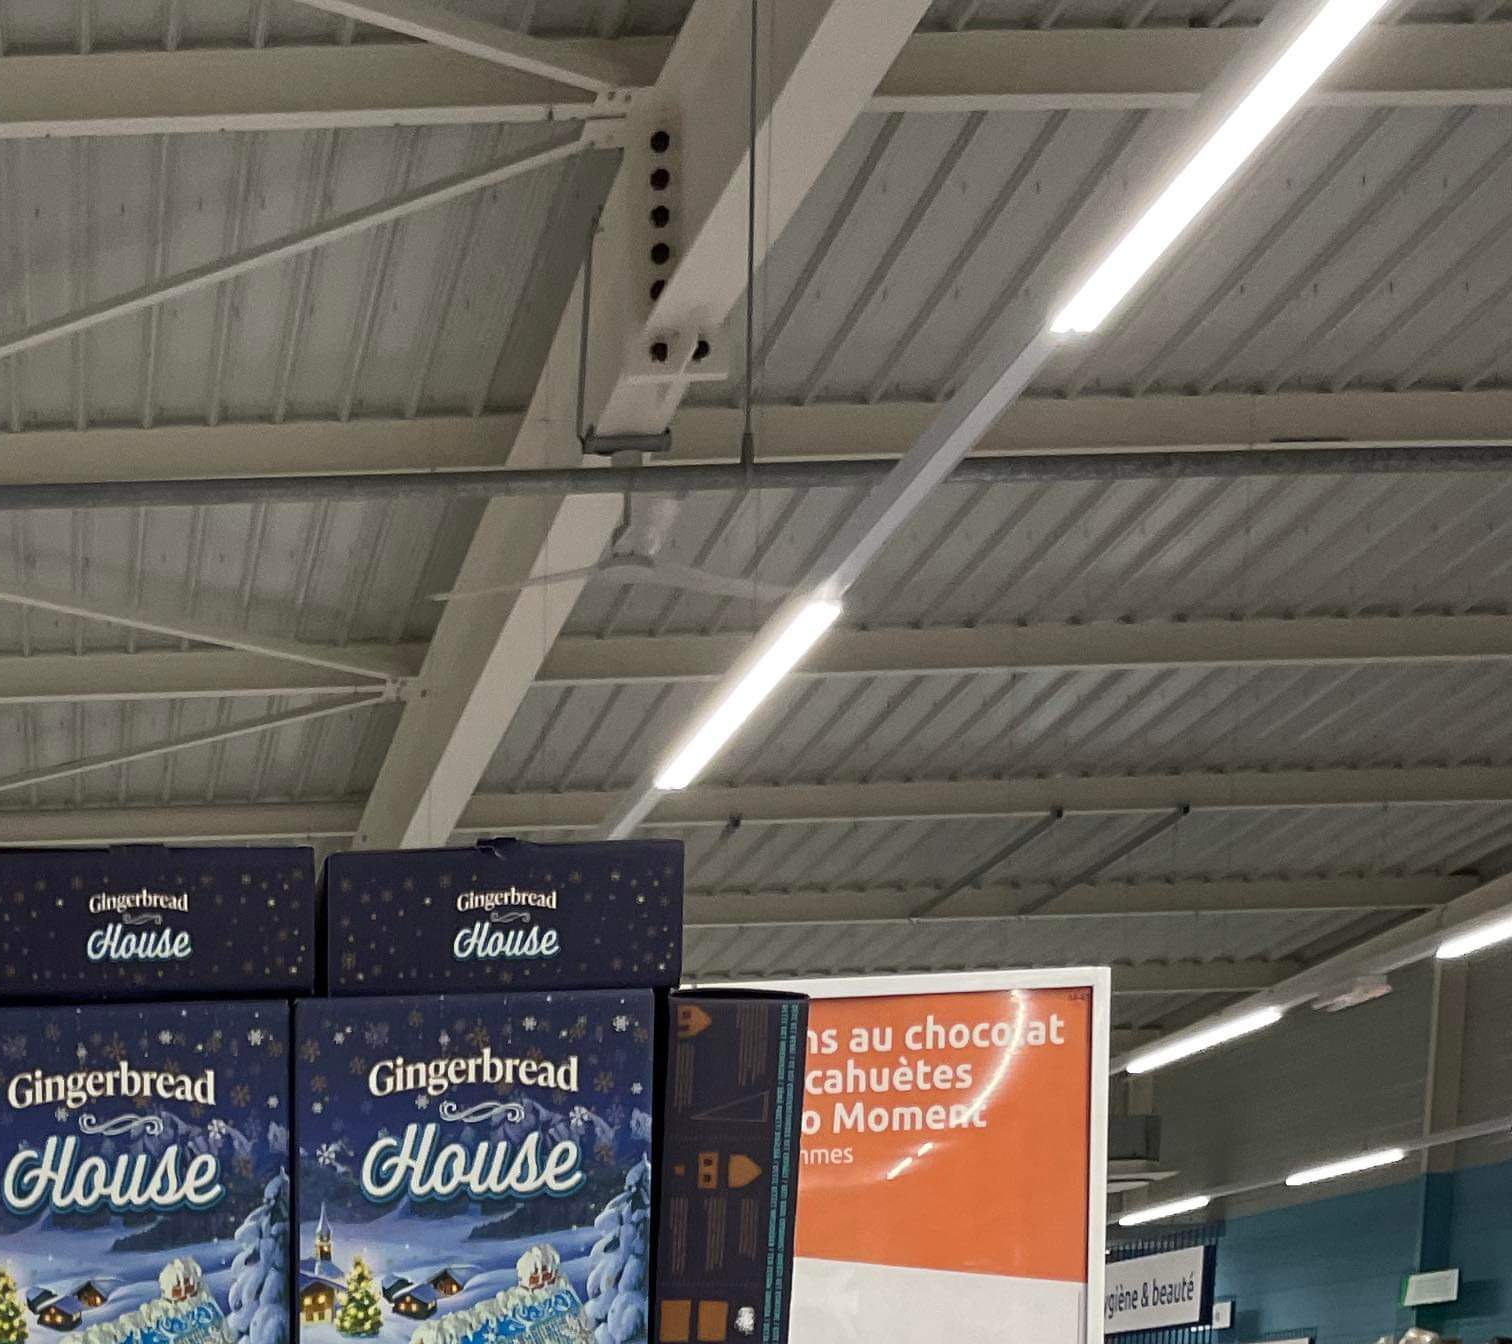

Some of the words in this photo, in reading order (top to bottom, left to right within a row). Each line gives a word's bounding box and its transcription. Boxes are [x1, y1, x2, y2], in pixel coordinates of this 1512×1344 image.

[89, 887, 190, 916] Gingerbread
[456, 886, 558, 913] Gingerbread
[86, 924, 193, 962] House
[453, 922, 561, 960] House
[849, 1025, 892, 1054] au
[6, 1059, 217, 1112] Gingerbread
[369, 1048, 580, 1098] Gingerbread
[804, 1056, 973, 1095] cahuètes
[832, 1101, 988, 1135] Moment
[2, 1133, 224, 1210] House
[360, 1121, 583, 1202] House
[1140, 1282, 1149, 1308] &
[1152, 1271, 1194, 1306] beauté
